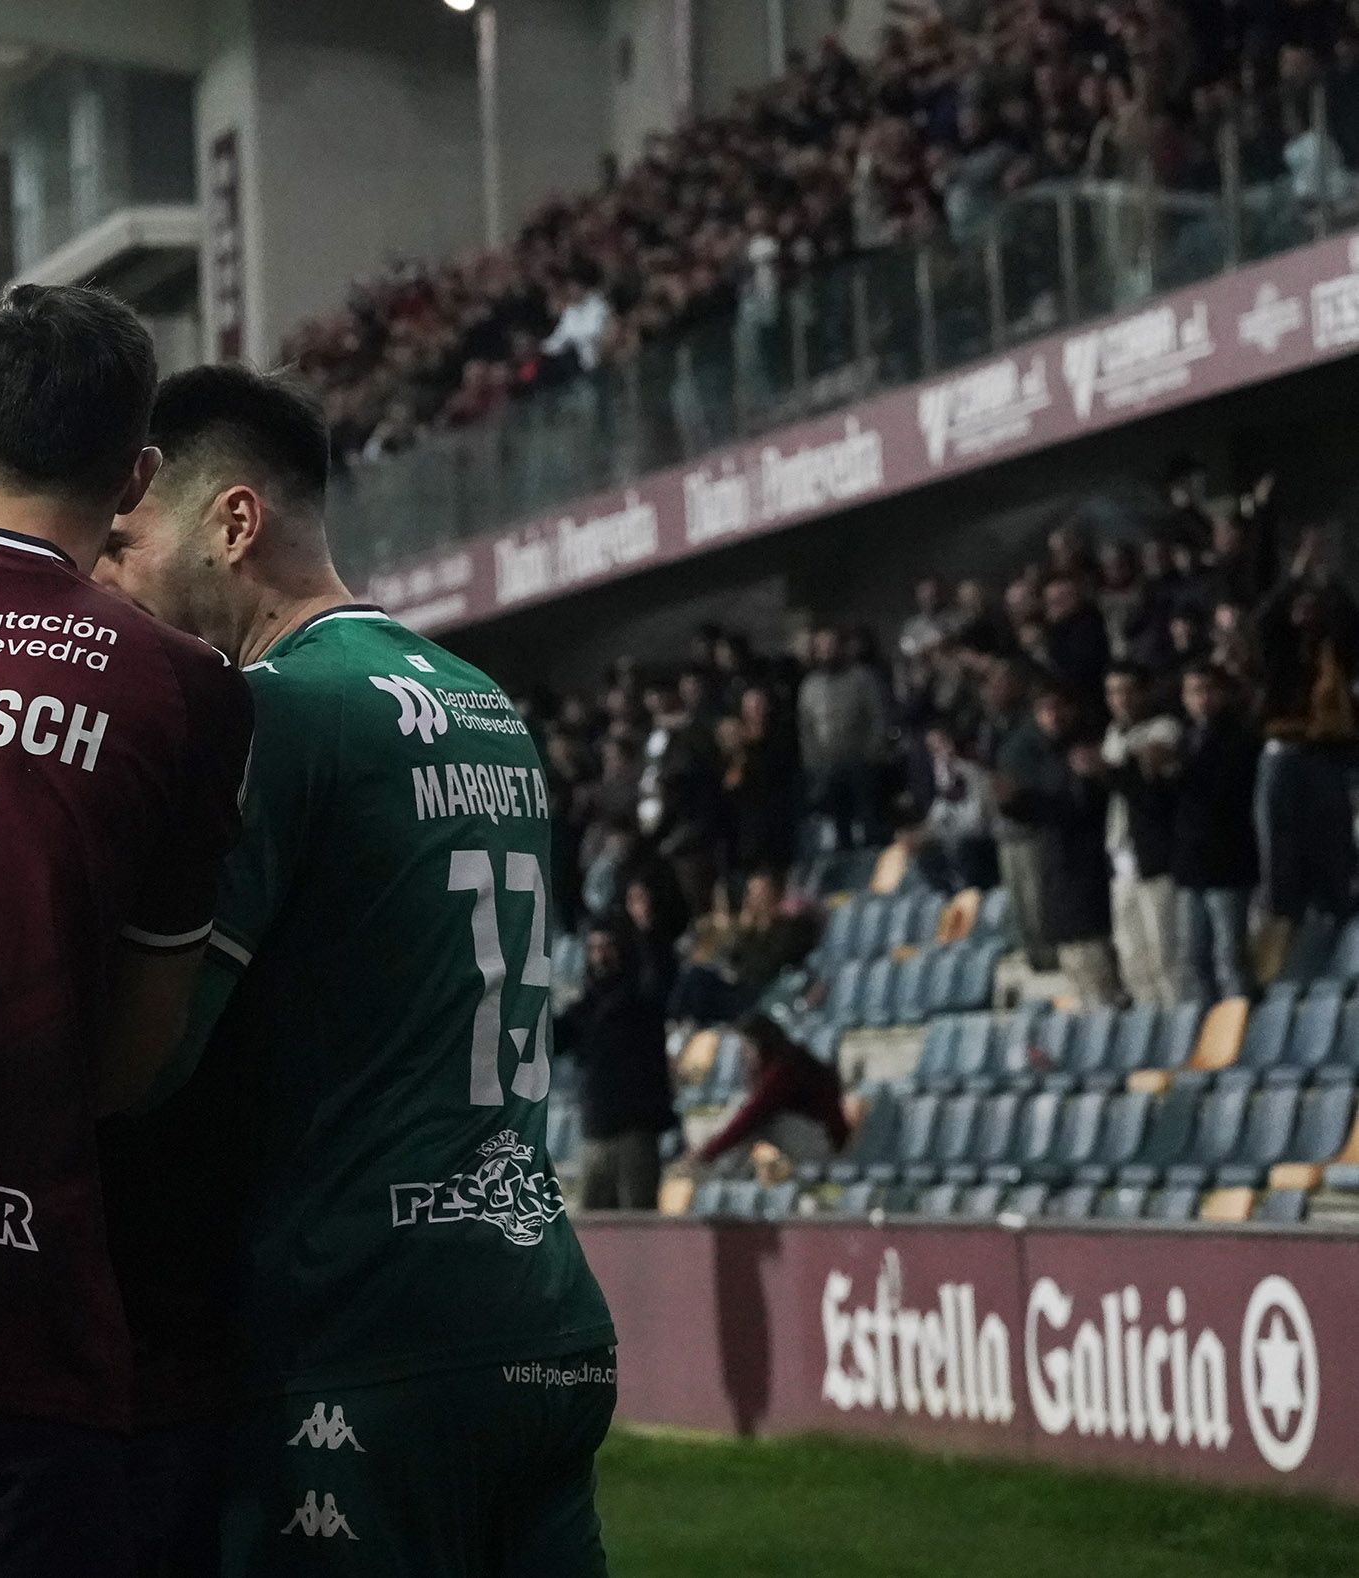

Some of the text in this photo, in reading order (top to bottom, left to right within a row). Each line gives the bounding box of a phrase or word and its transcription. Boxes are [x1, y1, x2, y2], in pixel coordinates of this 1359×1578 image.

[435, 687, 515, 712] Deputació
[450, 709, 528, 735] Pontevedra
[411, 763, 549, 826] MARQUETA
[447, 850, 551, 1106] 13
[821, 1247, 1233, 1452] Estrella Galicia
